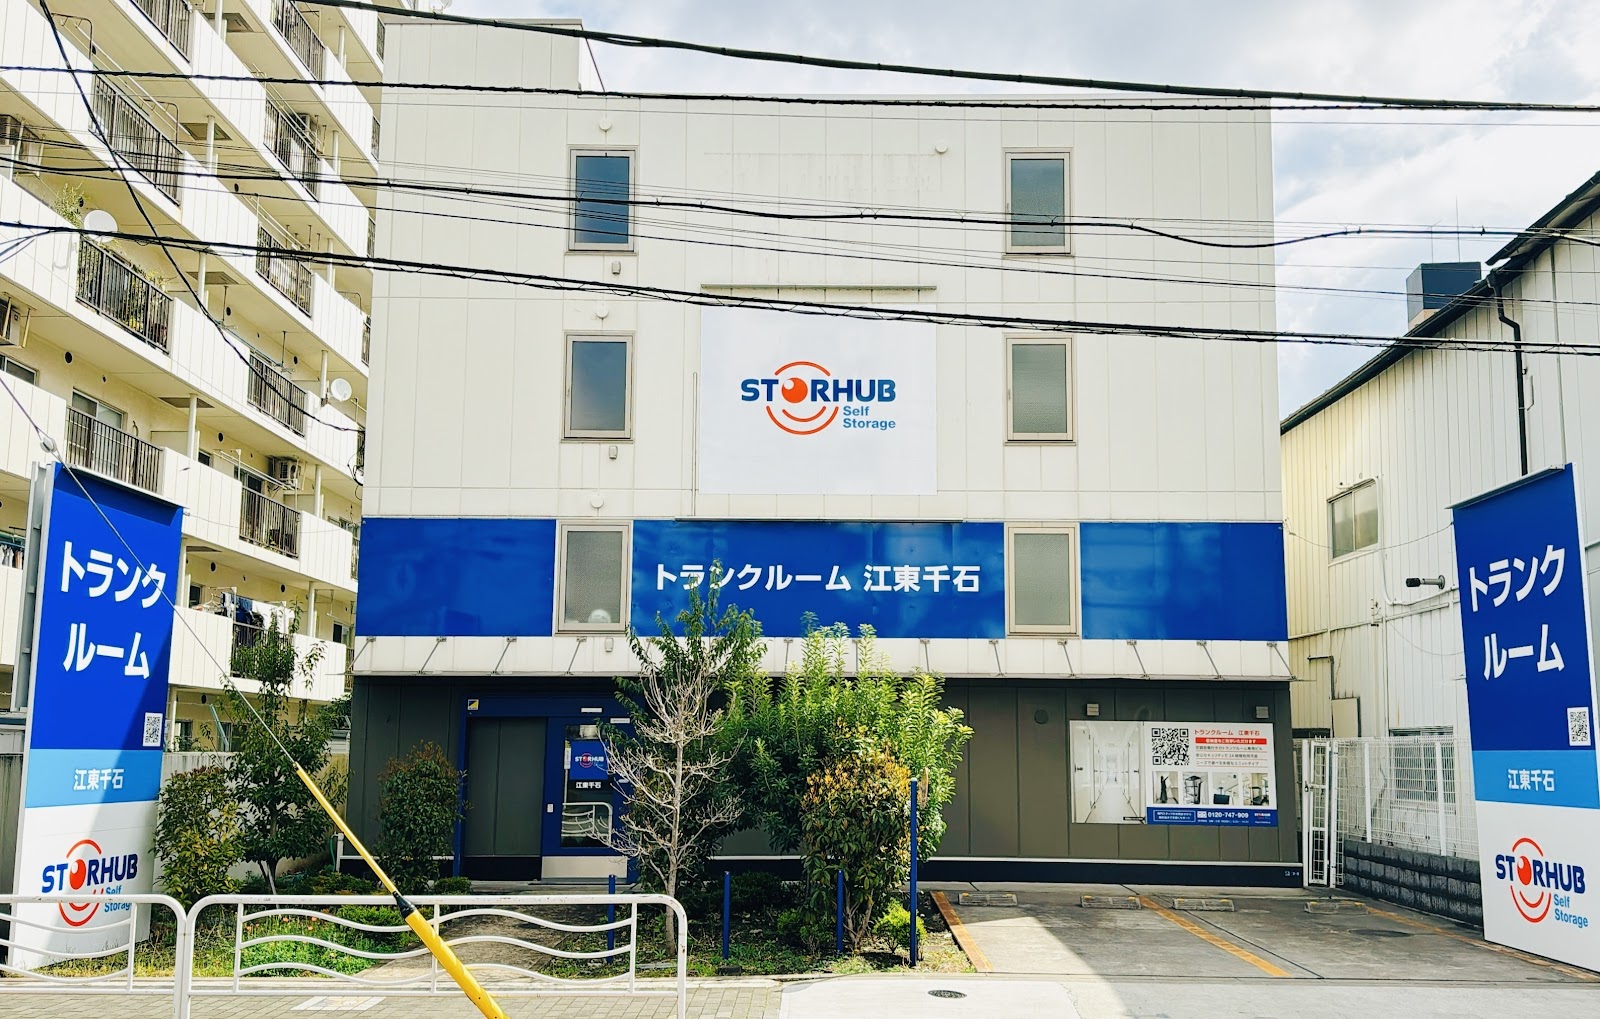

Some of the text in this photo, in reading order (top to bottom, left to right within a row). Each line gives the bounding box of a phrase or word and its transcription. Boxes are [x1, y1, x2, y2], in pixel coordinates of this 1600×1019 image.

[741, 378, 896, 403] STORHUB
[843, 405, 869, 416] Self
[843, 418, 896, 430] Storage
[61, 540, 166, 608] トランク
[657, 564, 981, 592] トランクルーム 江東千石
[1469, 544, 1565, 612] トランク
[63, 622, 150, 679] ルーム
[1483, 624, 1565, 681] ルーム
[73, 768, 124, 791] 江東千石
[1507, 768, 1555, 792] 江東千石
[41, 853, 138, 893] STORHUB
[1495, 854, 1586, 894] STORHUB
[104, 902, 132, 913] Storag
[1553, 893, 1570, 908] Self
[1554, 908, 1588, 929] Storage
